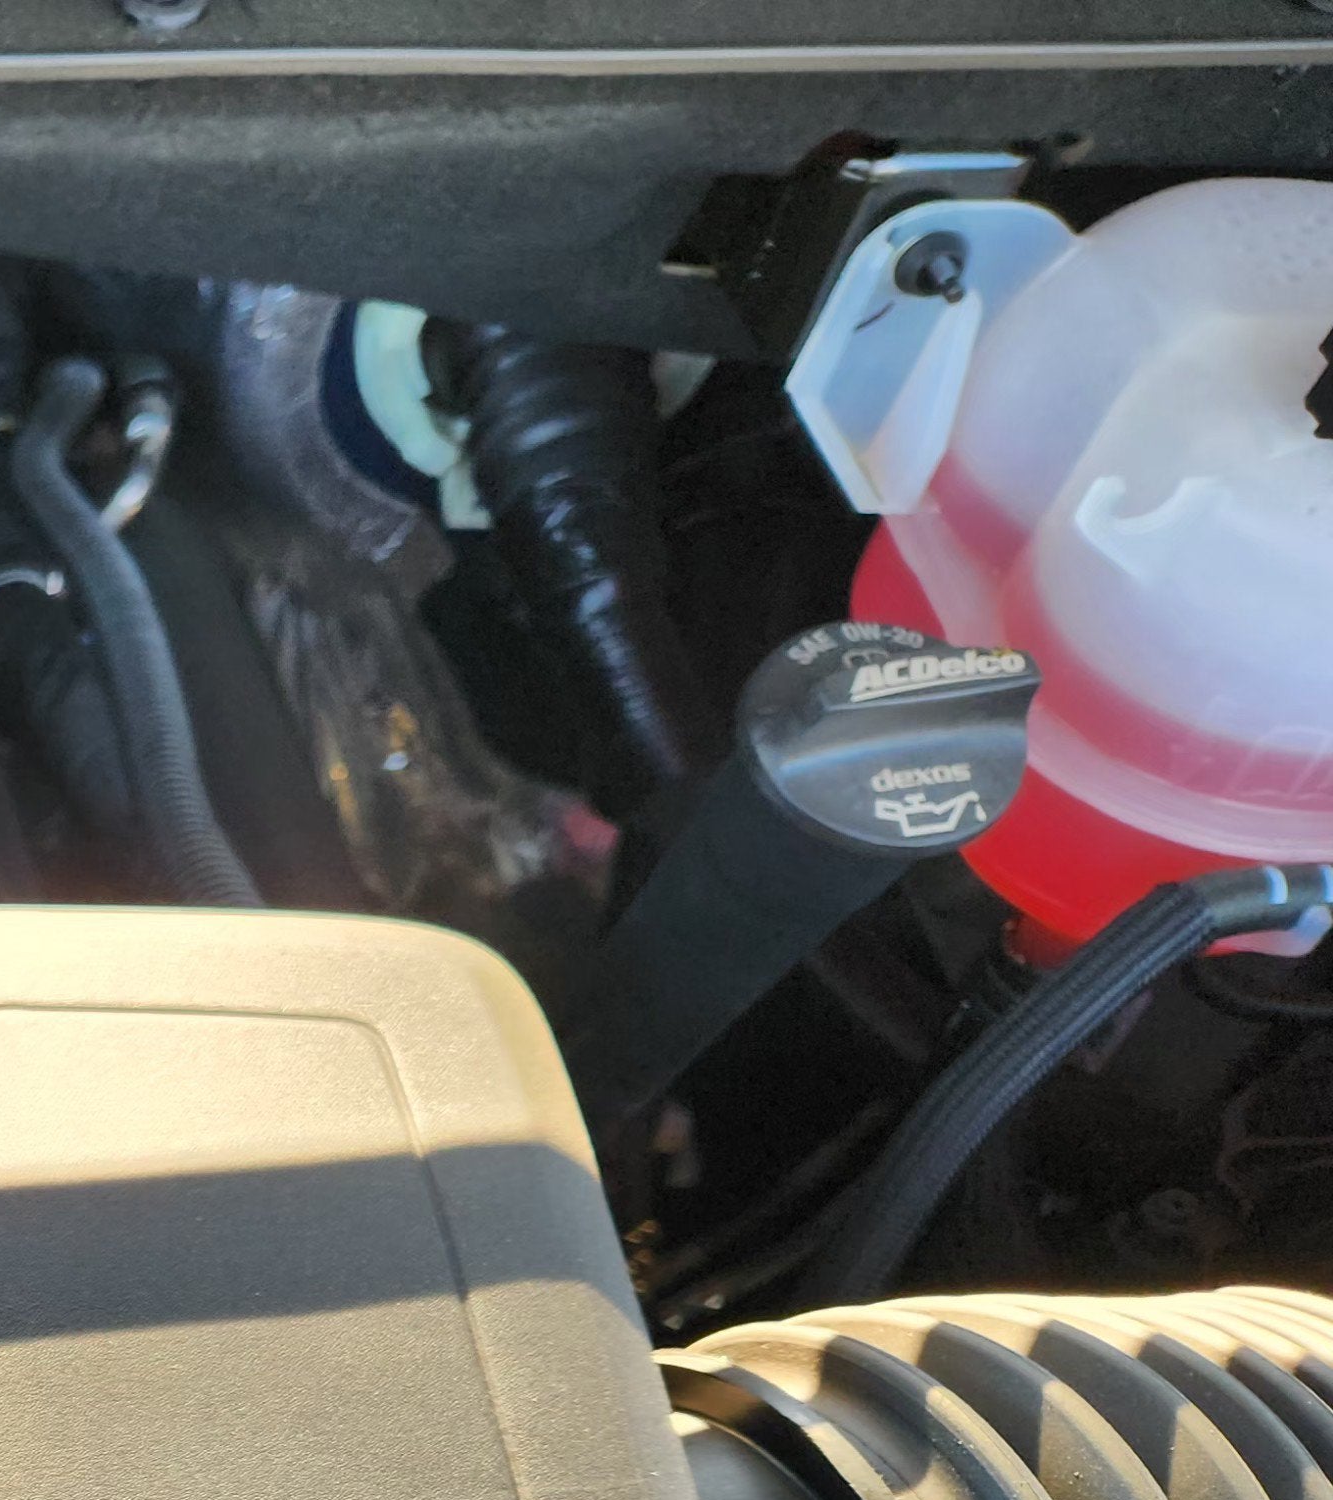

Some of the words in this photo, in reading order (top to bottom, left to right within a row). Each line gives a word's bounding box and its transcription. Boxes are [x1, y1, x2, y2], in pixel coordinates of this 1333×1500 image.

[787, 628, 837, 665] SAE
[850, 649, 1026, 698] ACDelco
[871, 763, 972, 792] dexos
